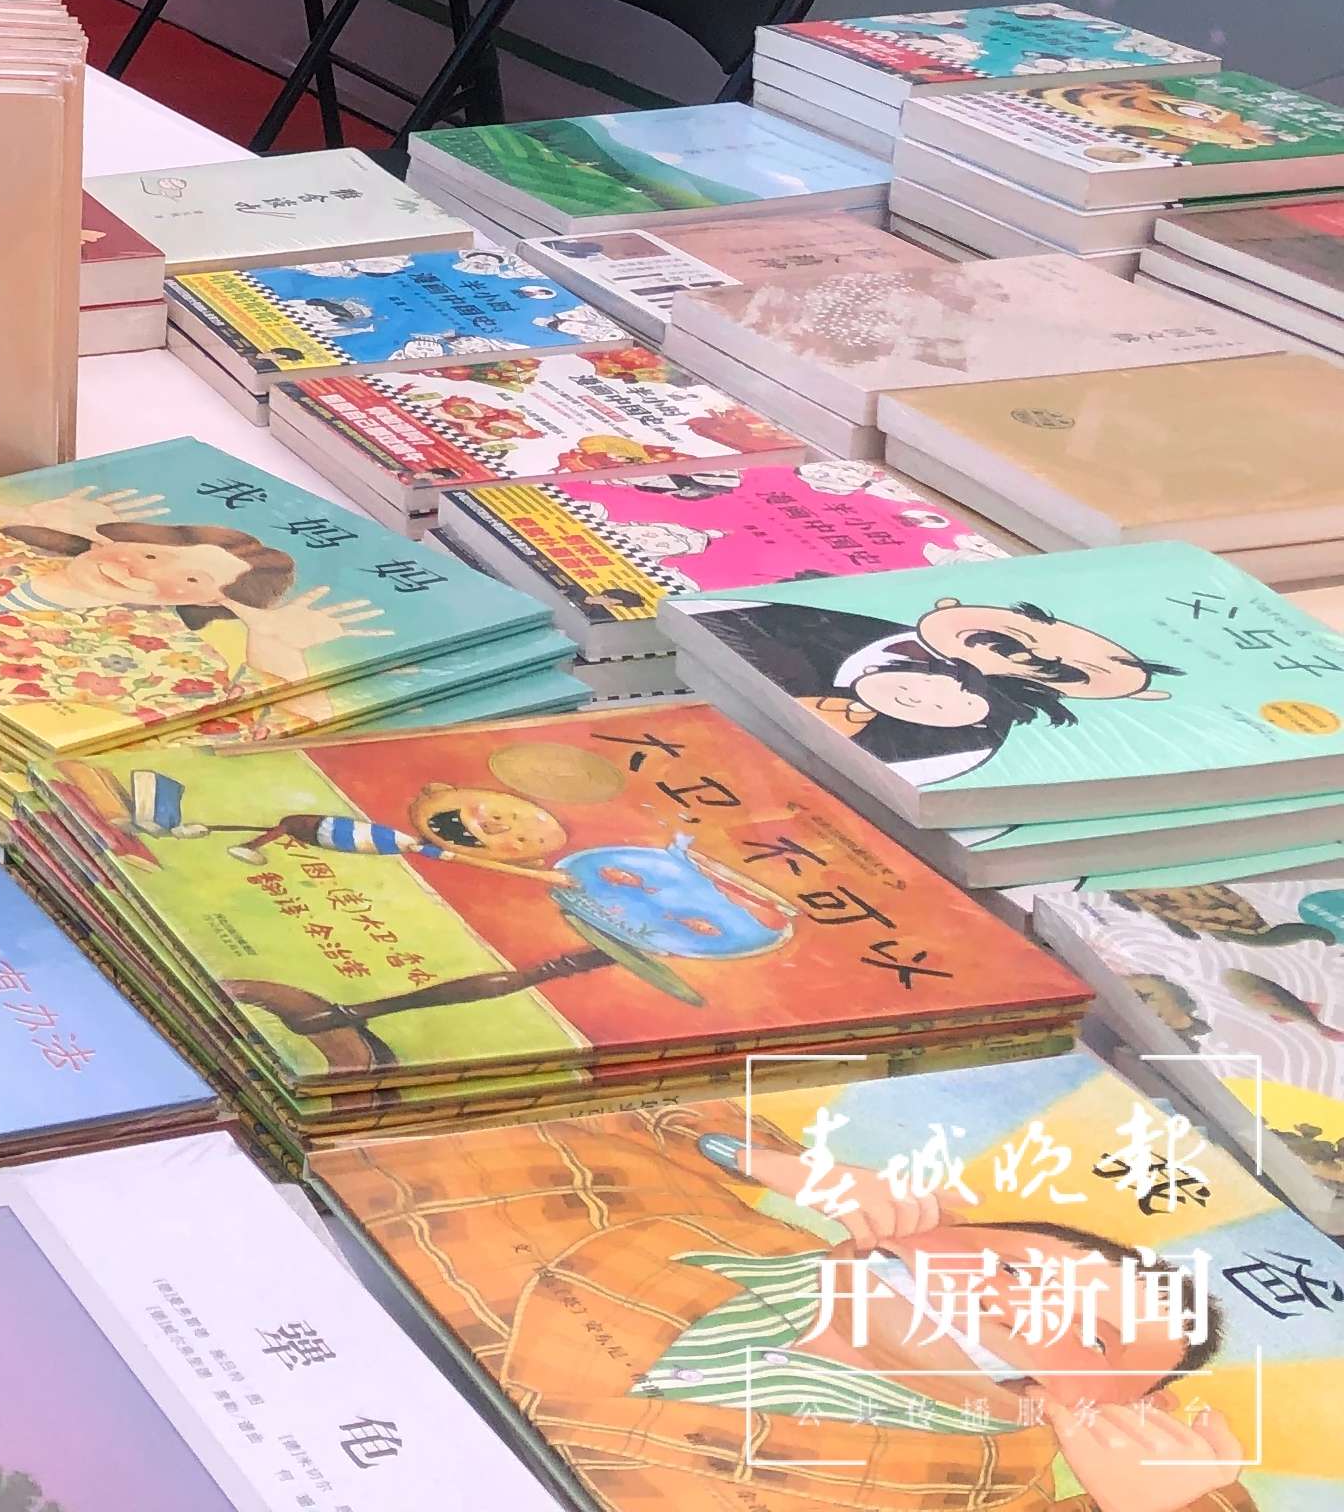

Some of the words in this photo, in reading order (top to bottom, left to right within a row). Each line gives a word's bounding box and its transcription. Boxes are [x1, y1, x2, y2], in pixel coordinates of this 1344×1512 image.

[564, 373, 673, 427] 漫画中国史
[617, 385, 693, 418] 半小时
[197, 475, 450, 594] 我妈妈
[753, 489, 899, 574] 漫画中国史
[815, 501, 908, 548] 半小时
